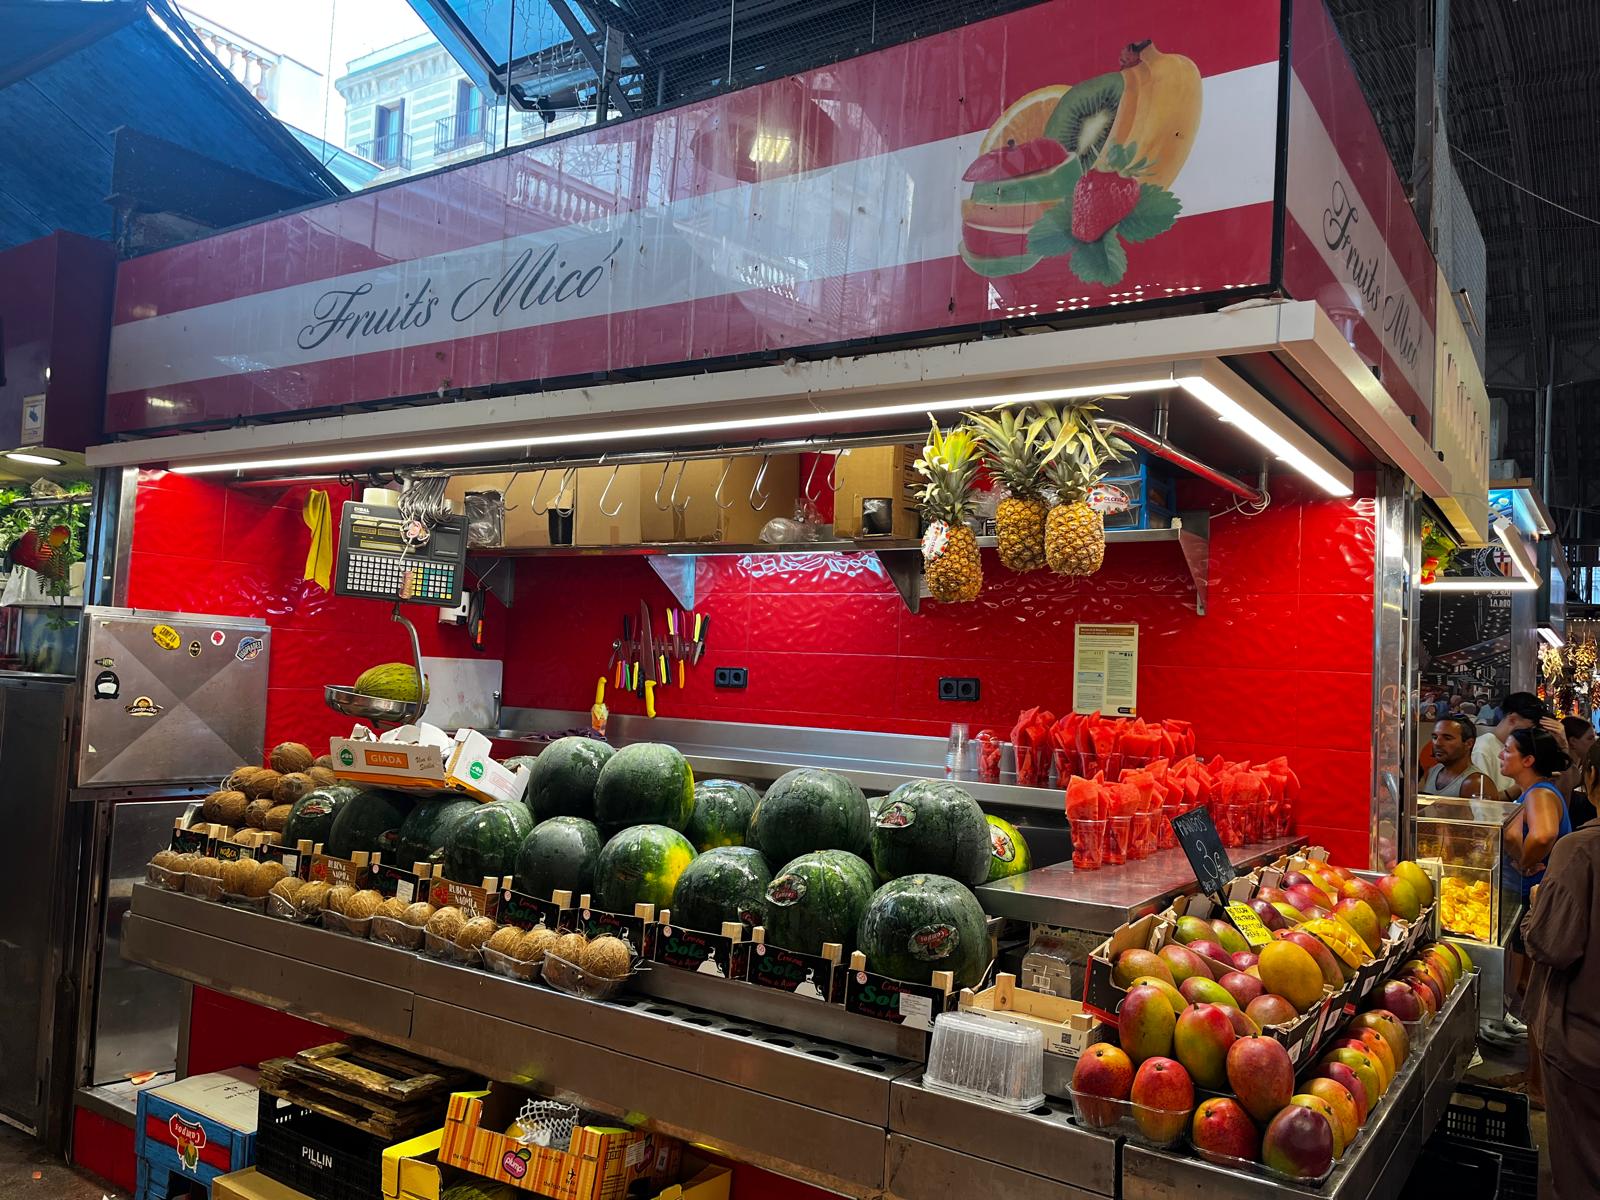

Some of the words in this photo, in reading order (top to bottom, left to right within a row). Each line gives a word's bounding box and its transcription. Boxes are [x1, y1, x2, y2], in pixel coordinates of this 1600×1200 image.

[1322, 180, 1382, 312] Fruits
[451, 238, 623, 322] Micó
[370, 753, 402, 765] GIADA
[174, 1123, 200, 1144] Campos
[302, 1146, 333, 1168] PILLIN
[504, 1156, 525, 1174] plump
